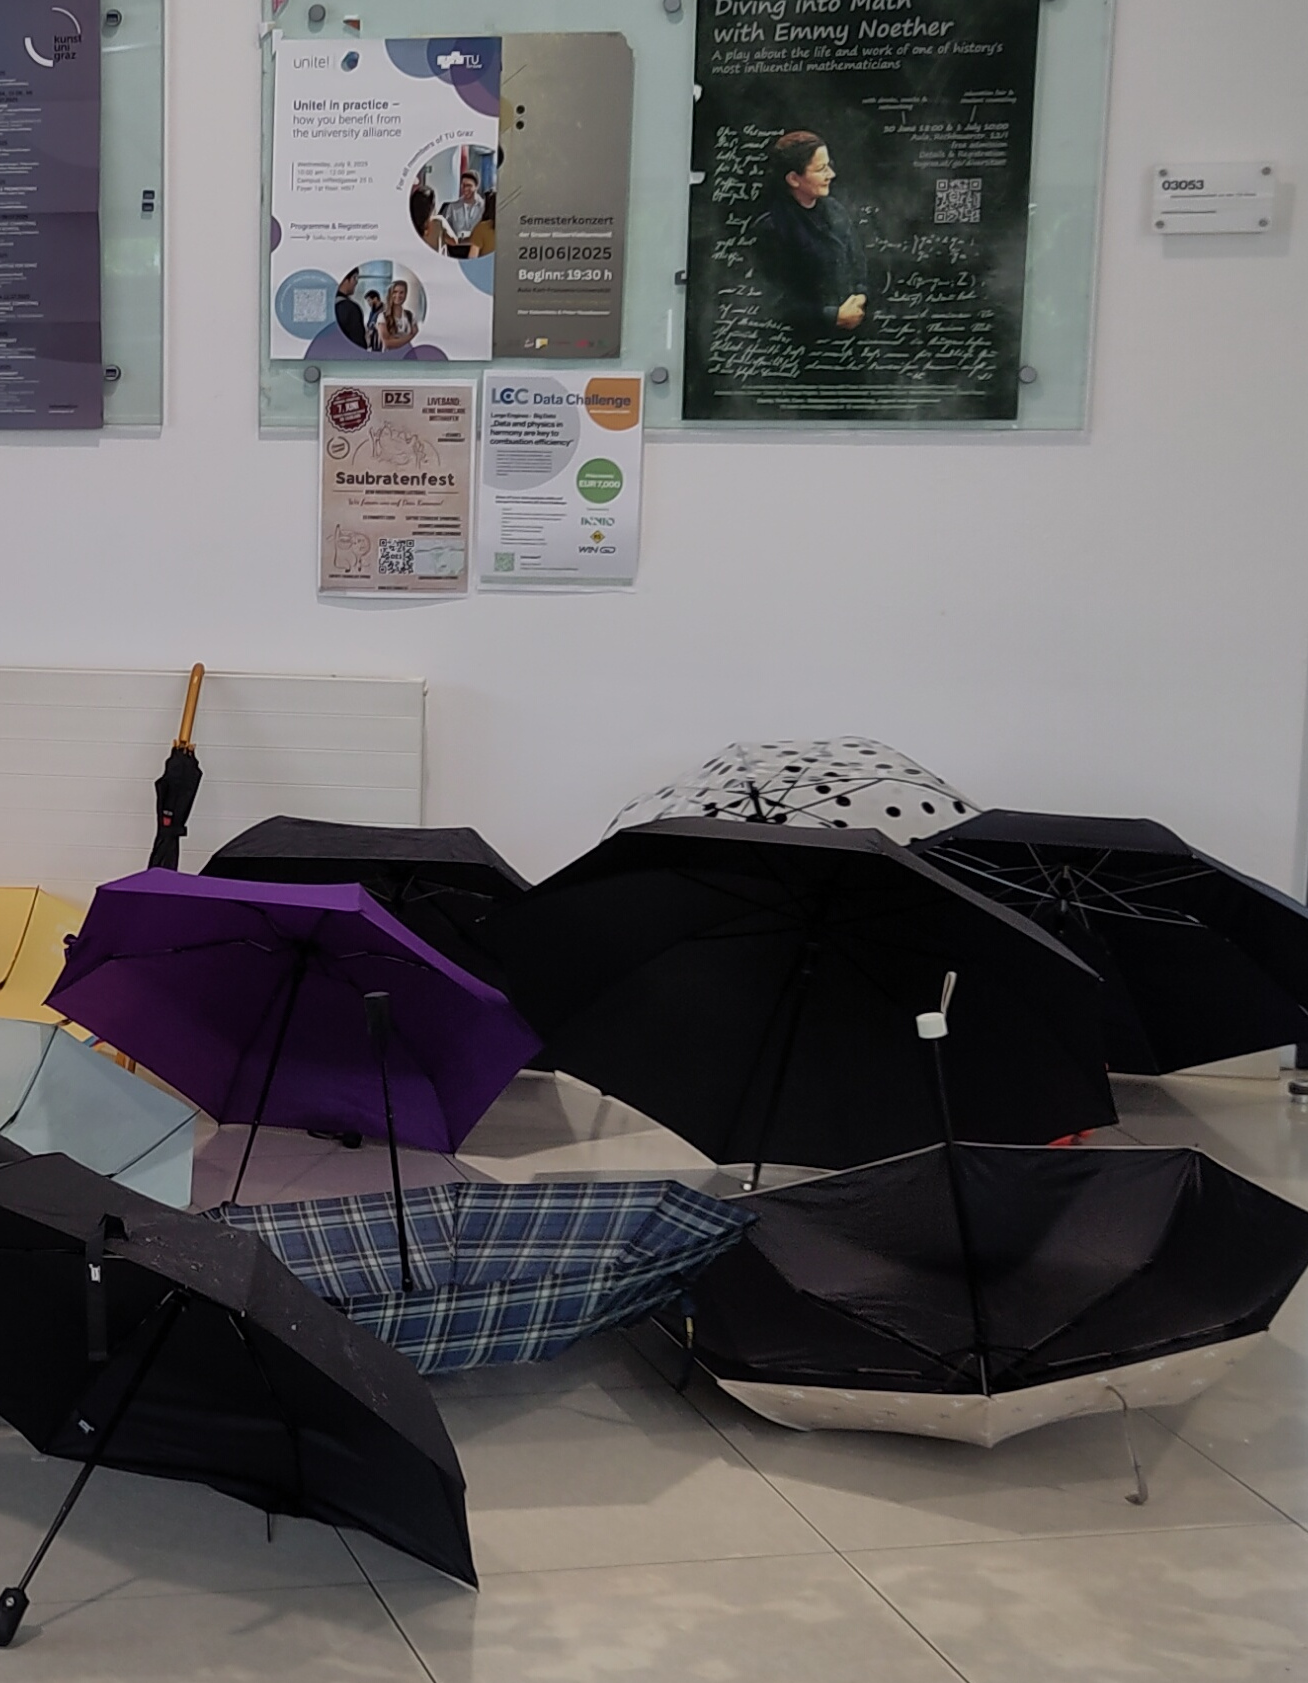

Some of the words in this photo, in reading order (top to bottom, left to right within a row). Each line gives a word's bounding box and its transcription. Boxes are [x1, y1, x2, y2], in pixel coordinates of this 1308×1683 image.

[714, 0, 787, 20] Diving
[714, 21, 765, 43] with
[774, 22, 849, 46] Emmy
[858, 15, 955, 39] Noether
[54, 34, 82, 44] kunst
[54, 44, 70, 52] uni
[711, 50, 722, 61] A
[724, 49, 750, 63] play
[753, 48, 787, 60] about
[790, 47, 810, 59] the
[813, 45, 831, 58] life
[834, 45, 858, 58] and
[862, 45, 892, 57] work
[895, 43, 910, 56] of
[912, 45, 933, 55] one
[937, 43, 952, 55] of
[54, 52, 77, 63] graz
[293, 56, 330, 69] unite!
[463, 54, 479, 64] TU
[711, 63, 741, 74] most
[744, 60, 803, 73] influential
[806, 58, 902, 72] mathematicians
[293, 99, 326, 111] Unite!
[329, 99, 340, 111] in
[342, 98, 389, 113] practice
[293, 114, 314, 125] how
[317, 116, 336, 127] you
[338, 113, 374, 125] benefit
[376, 113, 402, 125] from
[293, 128, 309, 138] the
[311, 128, 361, 140] university
[362, 126, 402, 138] alliance
[435, 135, 443, 144] of
[444, 132, 455, 140] TU
[456, 130, 474, 138] Graz
[1161, 179, 1205, 191] 03053
[290, 222, 330, 231] Programme
[519, 215, 614, 226] Semesterkonzert
[518, 245, 612, 262] 28|06|2025
[518, 268, 565, 283] Beginn:
[566, 269, 602, 281] 19:30
[604, 268, 613, 281] h
[384, 392, 411, 405] DZS
[533, 393, 563, 405] Data
[565, 393, 631, 408] Challenge
[526, 421, 555, 429] physics
[490, 429, 523, 437] harmony
[536, 430, 551, 438] key
[335, 470, 456, 486] Saubratenfest
[596, 480, 621, 489] 7,000
